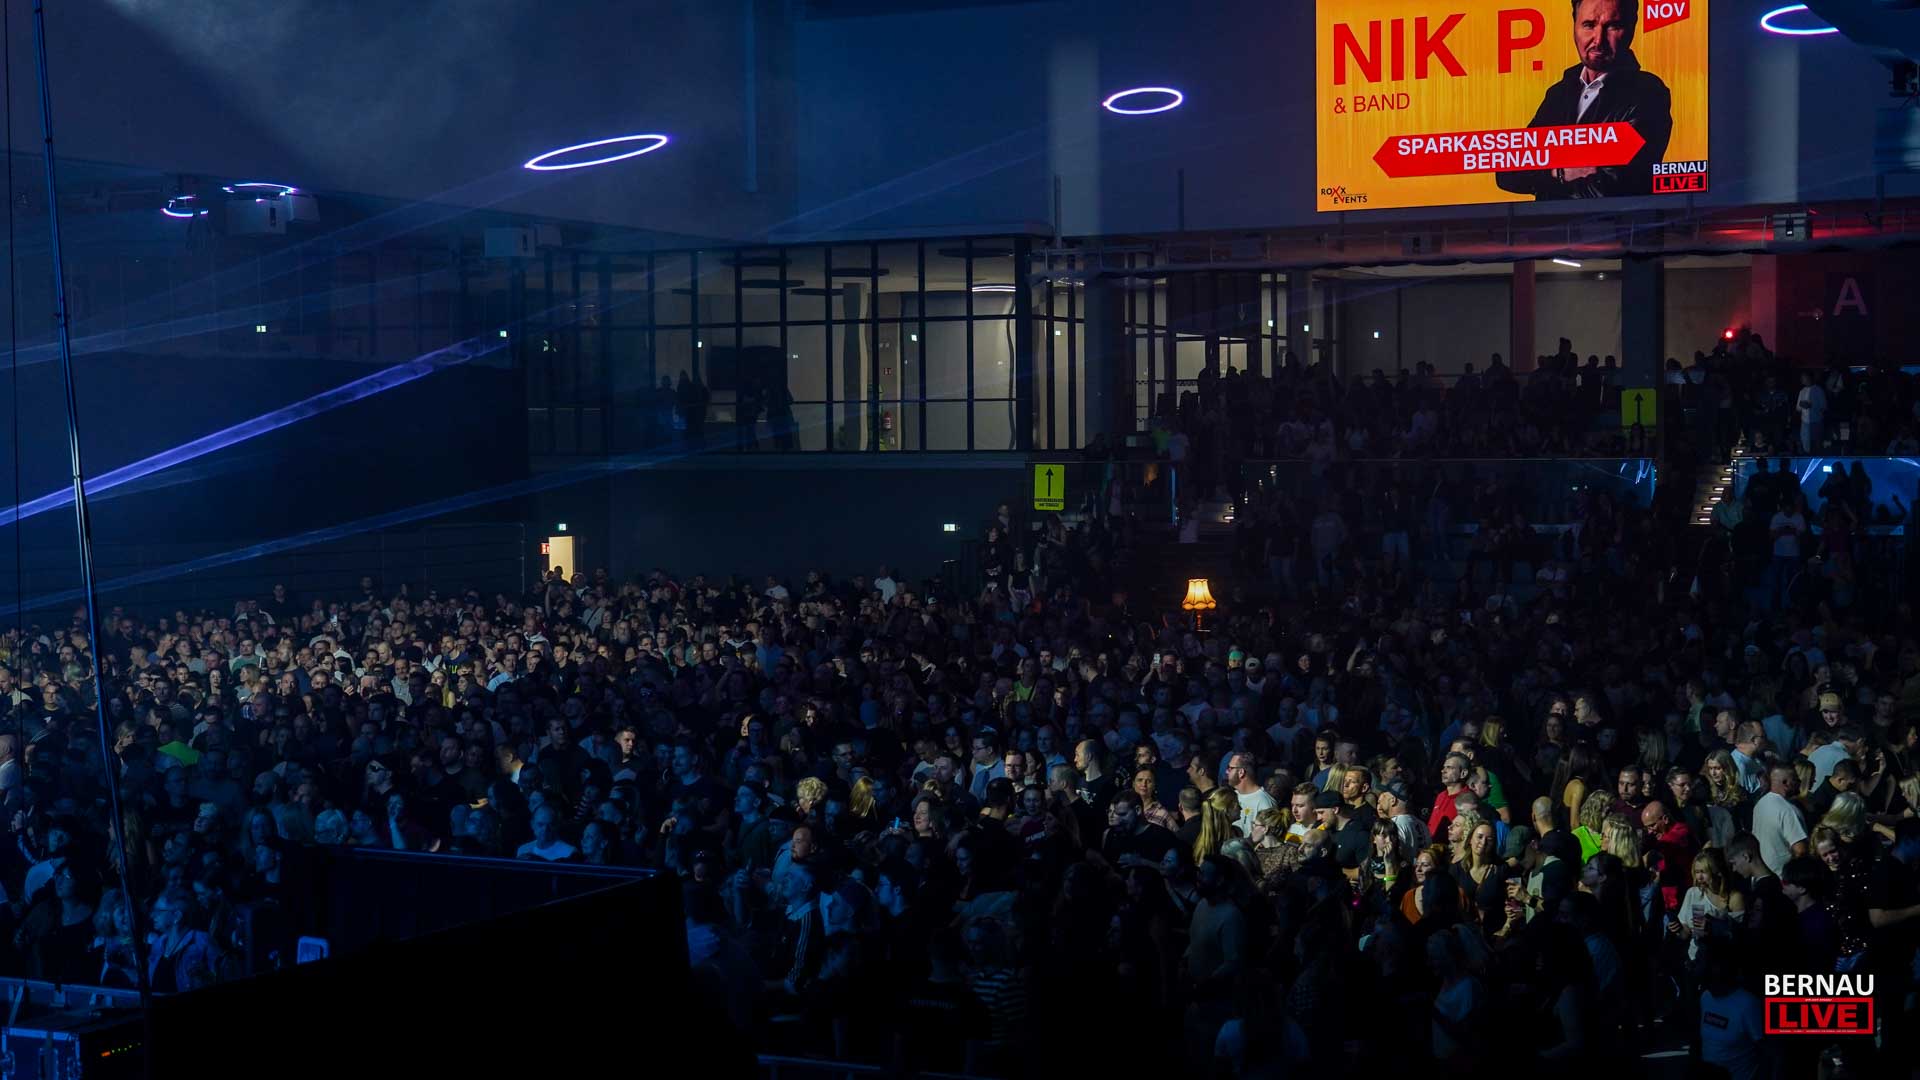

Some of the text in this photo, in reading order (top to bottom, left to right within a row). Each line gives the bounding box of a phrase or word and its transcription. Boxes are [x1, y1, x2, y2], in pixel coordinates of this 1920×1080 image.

[1647, 2, 1686, 19] NOV
[1333, 8, 1546, 85] NIK P.
[1334, 92, 1410, 114] & BAND
[1397, 126, 1618, 156] SPARKASSEN ARENA
[1463, 149, 1550, 171] BERNAU
[1652, 160, 1707, 176] BERNAU
[1658, 176, 1699, 190] LIVE
[1333, 195, 1368, 204] EVENTS
[1832, 277, 1869, 316] A
